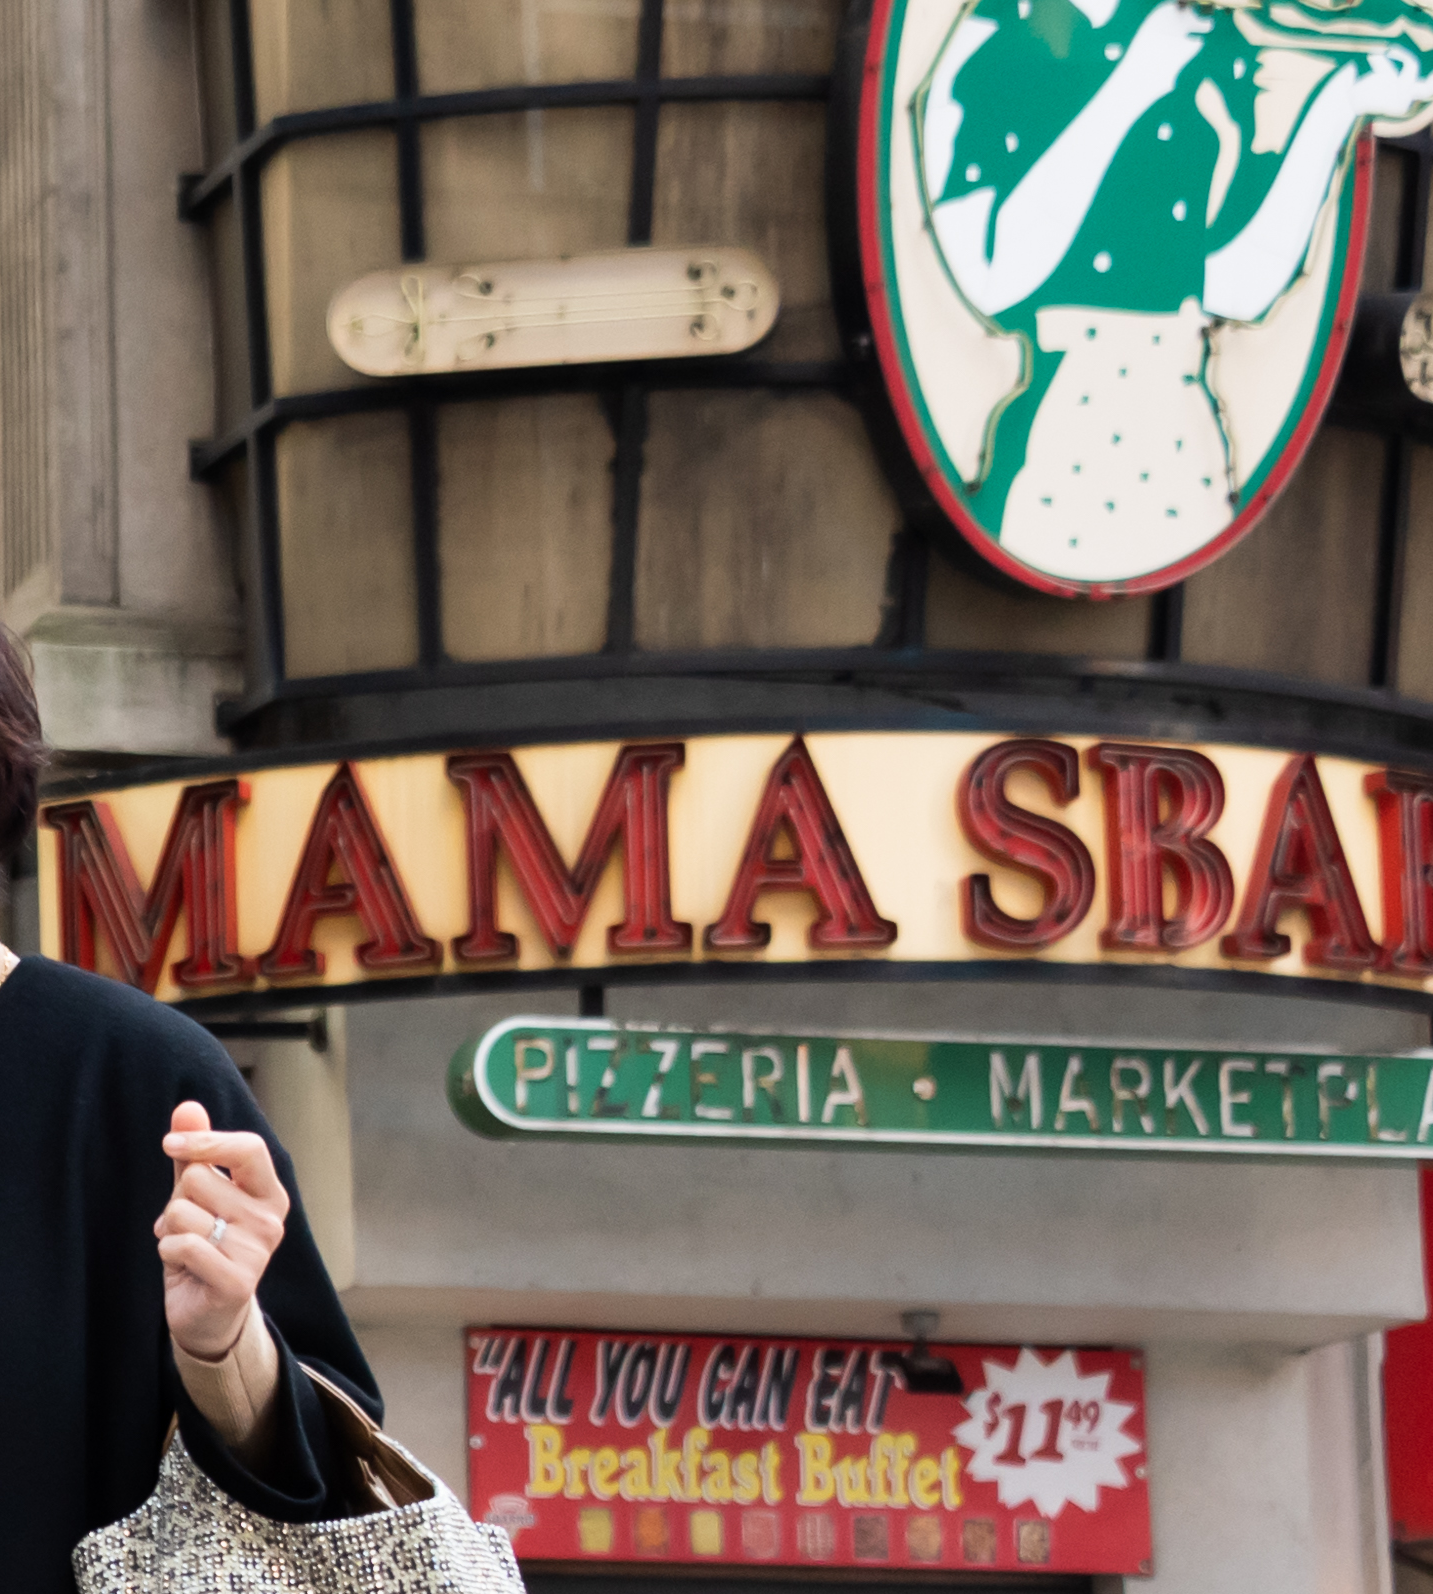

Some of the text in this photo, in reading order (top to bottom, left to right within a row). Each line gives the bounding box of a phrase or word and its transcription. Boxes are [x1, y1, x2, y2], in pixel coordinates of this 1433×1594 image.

[41, 734, 899, 996] MAMA
[512, 1034, 869, 1128] PIZZERIA
[589, 1338, 692, 1429] YOU
[697, 1341, 800, 1433] CAN
[524, 1422, 964, 1511] Breakfast Buffet
